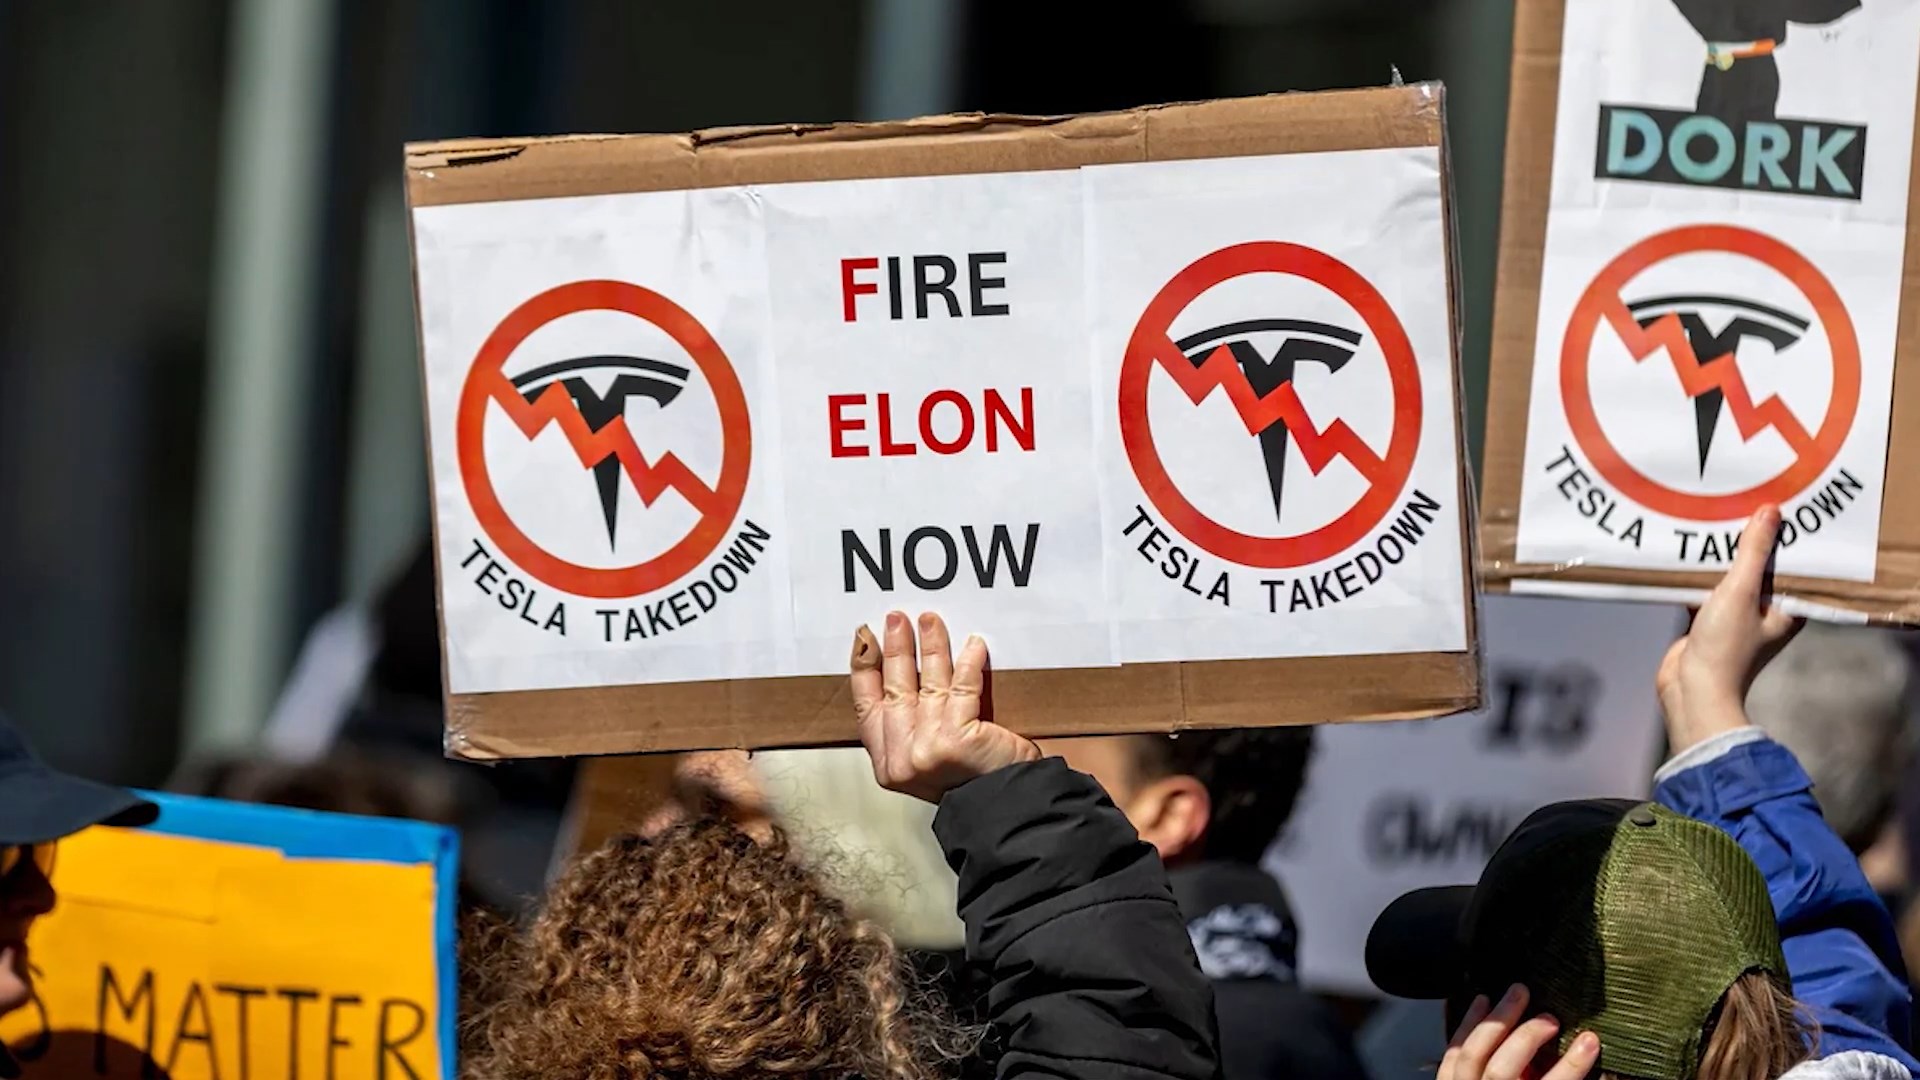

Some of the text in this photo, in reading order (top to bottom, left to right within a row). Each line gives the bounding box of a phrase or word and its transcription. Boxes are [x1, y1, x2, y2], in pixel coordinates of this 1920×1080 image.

[1606, 110, 1857, 194] DORK
[841, 252, 1010, 322] FIRE
[828, 388, 1036, 457] ELON
[1122, 489, 1441, 613] TESLA TAKEDOWN
[1546, 446, 1864, 562] TESLA TAKDOWN
[461, 520, 771, 642] TESLA TAKEDOWN
[842, 524, 1040, 592] NOW
[97, 963, 427, 1080] MATTER
